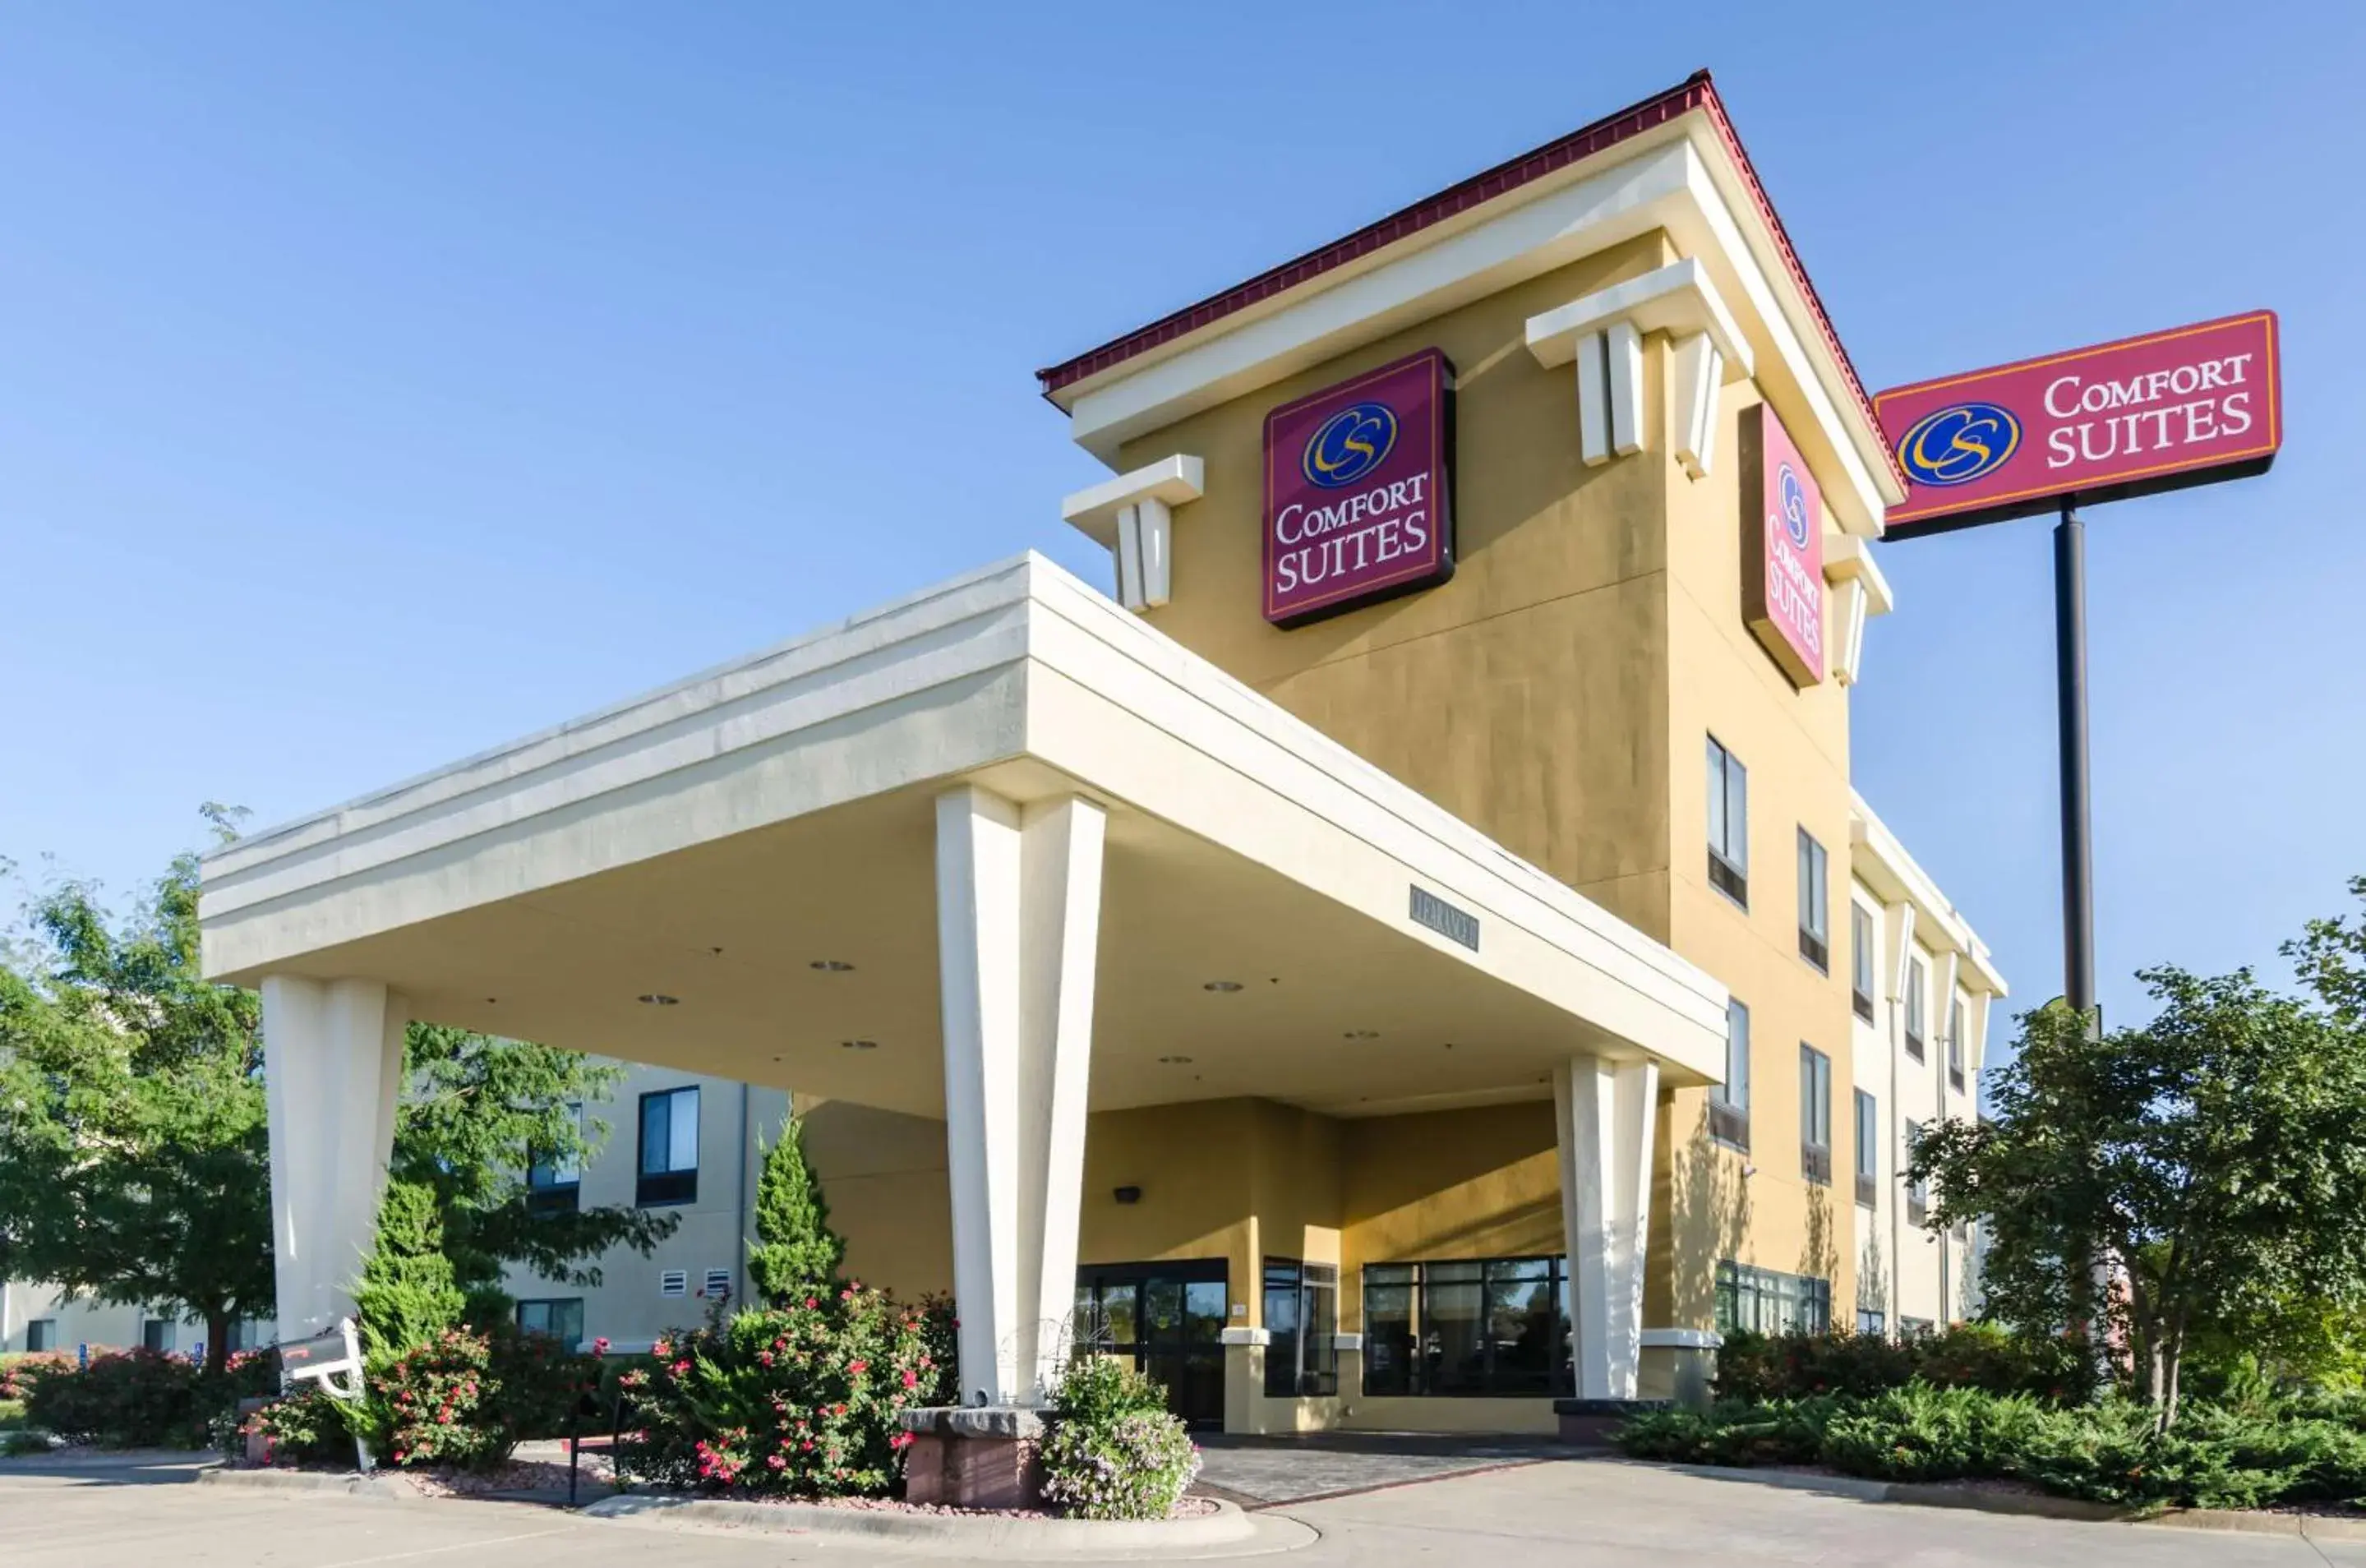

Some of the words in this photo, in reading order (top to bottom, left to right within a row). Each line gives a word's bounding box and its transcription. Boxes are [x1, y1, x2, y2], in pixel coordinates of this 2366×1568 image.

[2044, 353, 2253, 419] COMFORT
[2046, 392, 2253, 469] SUITES
[1276, 473, 1429, 545] COMFORT
[1277, 510, 1427, 593] SUITES
[1770, 560, 1819, 654] SUITES
